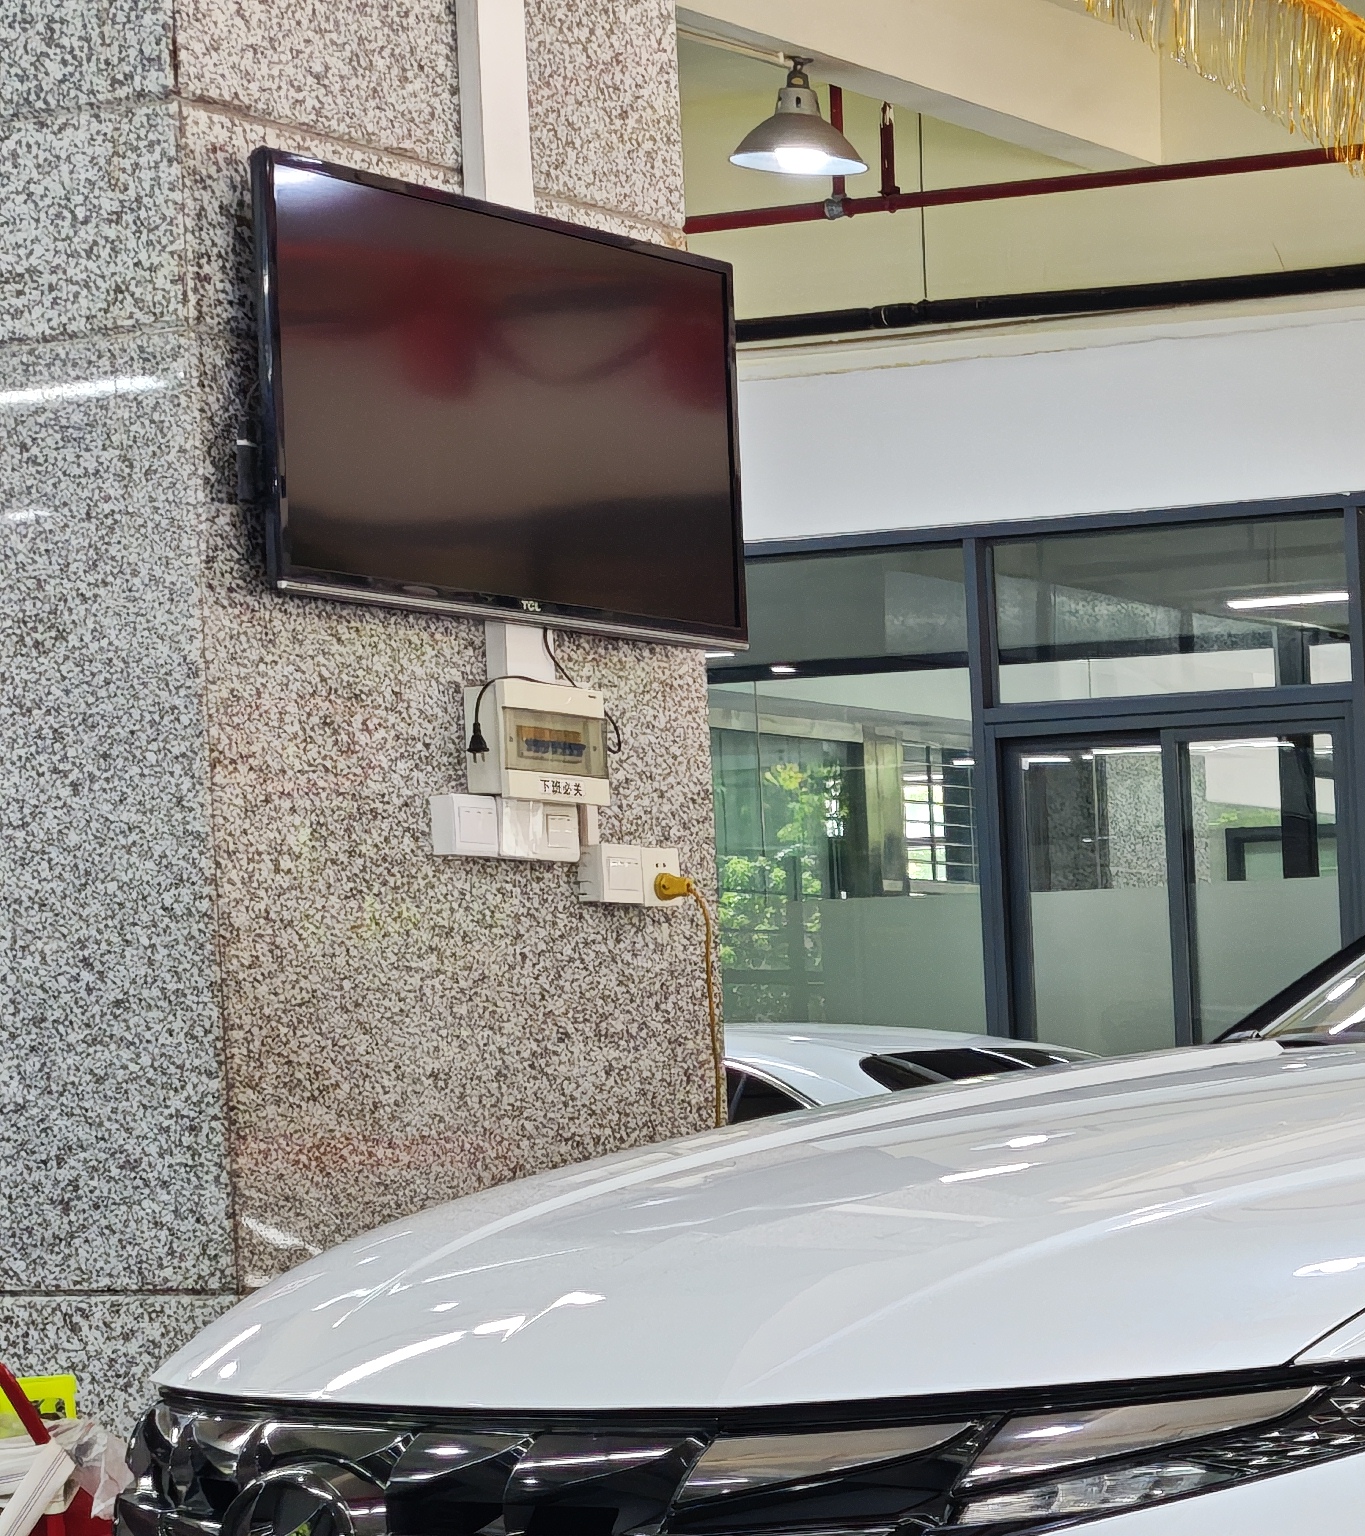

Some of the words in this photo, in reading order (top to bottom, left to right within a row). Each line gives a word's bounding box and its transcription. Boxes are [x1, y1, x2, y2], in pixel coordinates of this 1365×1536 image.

[520, 599, 542, 612] TCL
[539, 778, 583, 797] 下班必关
